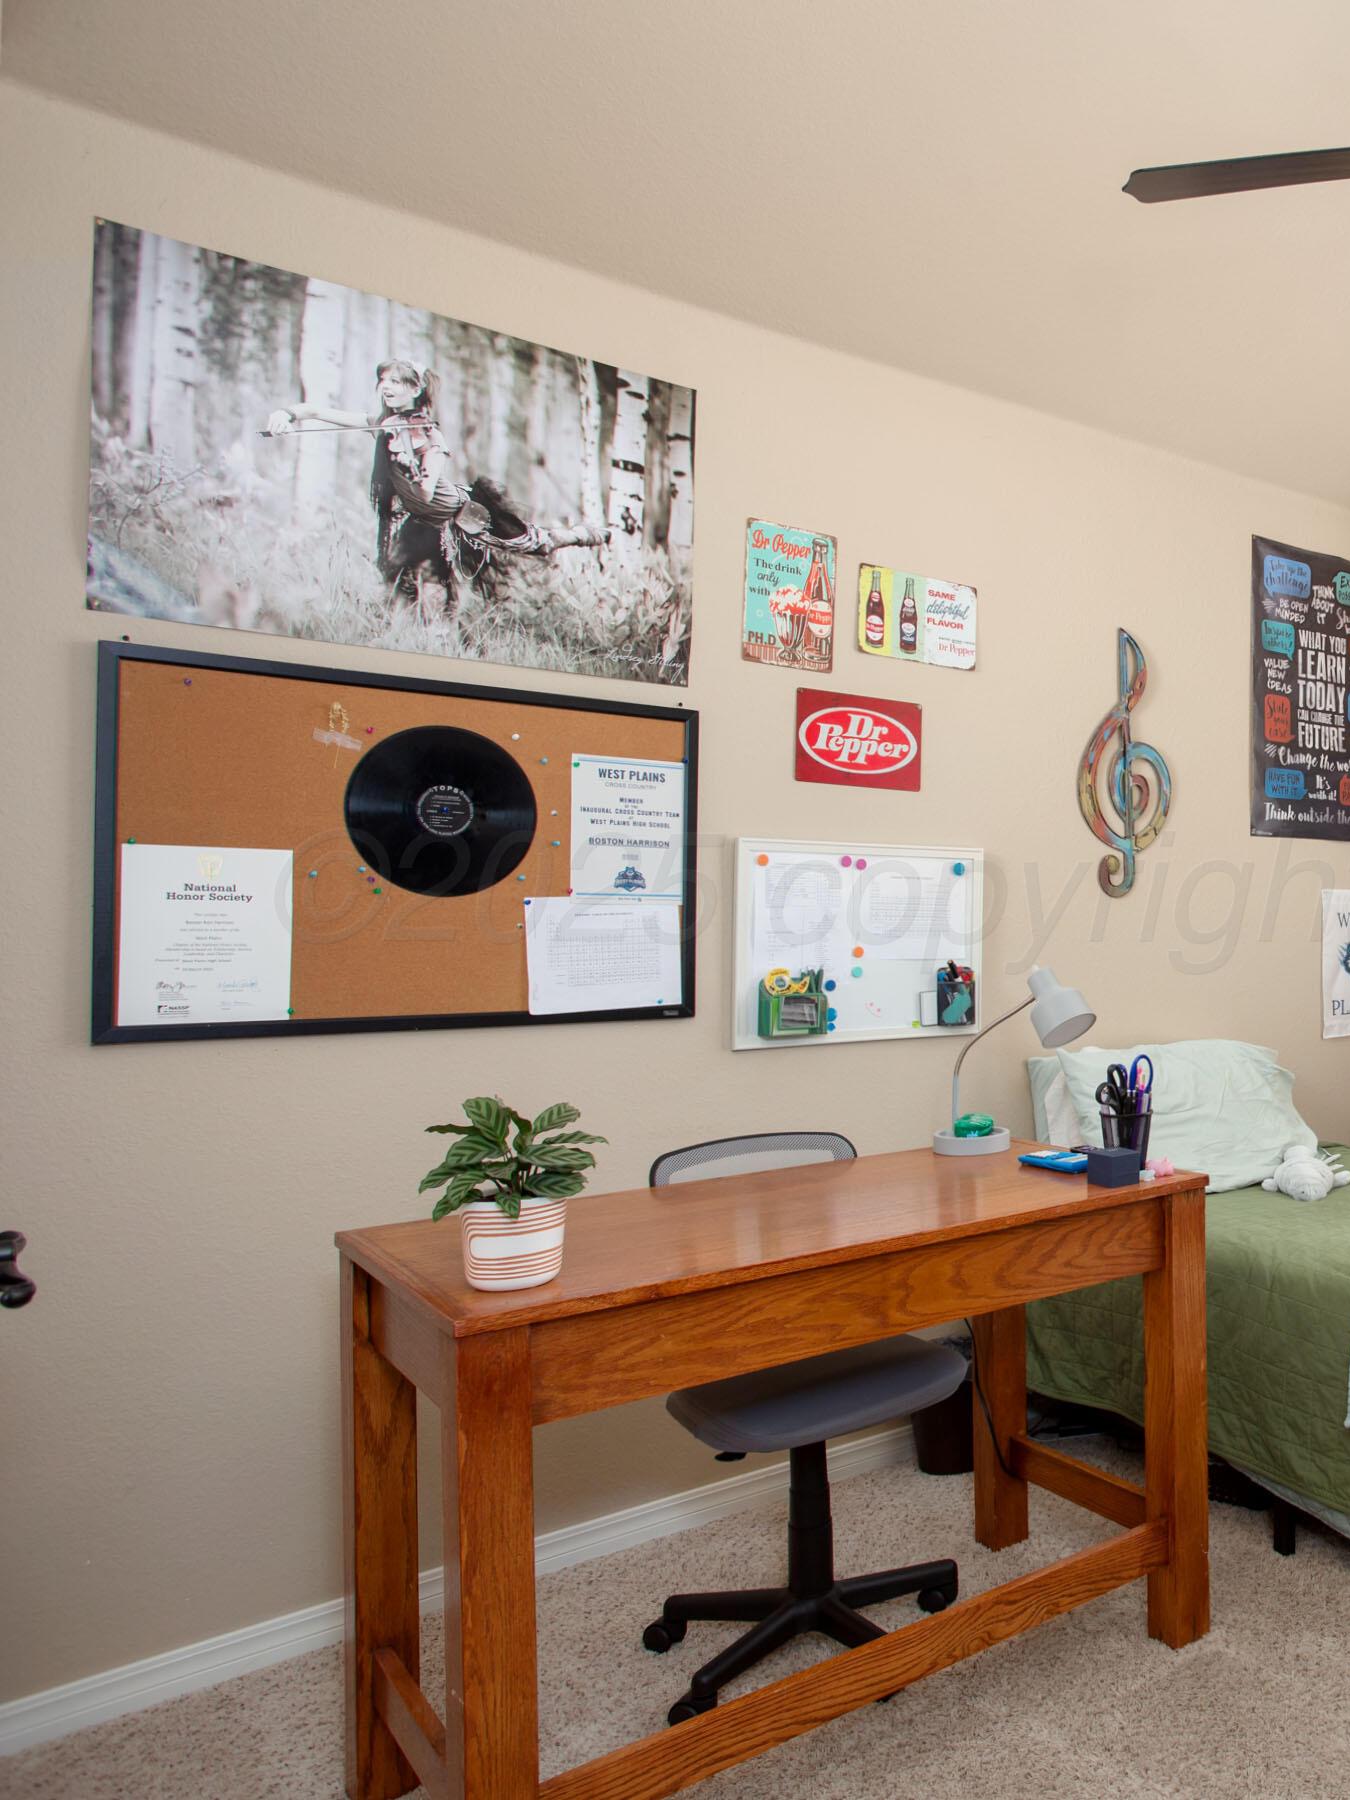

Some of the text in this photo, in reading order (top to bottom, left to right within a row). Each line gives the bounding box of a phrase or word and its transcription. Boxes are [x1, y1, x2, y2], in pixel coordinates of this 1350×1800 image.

[752, 528, 812, 560] Dr Pepper
[753, 557, 802, 576] The drink
[757, 571, 780, 588] only
[748, 585, 771, 597] with
[928, 589, 957, 601] SAME
[1312, 585, 1336, 600] THINK
[926, 599, 971, 620] delightful
[1279, 598, 1310, 614] BE OPEN
[1311, 599, 1336, 614] ABOUT
[927, 617, 965, 630] FLAVOR
[1274, 608, 1306, 624] MINDED
[747, 630, 776, 646] PH.D
[1298, 629, 1347, 656] WHAT YOU
[939, 643, 975, 658] Dr Pepper
[1263, 658, 1291, 670] VALUE
[1297, 648, 1347, 686] LEARN
[1267, 668, 1287, 681] NEW
[1266, 679, 1293, 695] IDEAS
[1296, 679, 1347, 715] TODAY
[1297, 708, 1345, 727] CAN CHANGE THE
[842, 713, 889, 741] Dr
[811, 722, 910, 765] Pepper
[1297, 721, 1347, 753] FUTURE
[1278, 745, 1319, 771] Change
[1319, 753, 1336, 772] the
[598, 768, 666, 783] WEST PLAINS
[1315, 774, 1332, 790] It's
[604, 781, 657, 790] CROSS COUNTRY
[580, 806, 612, 814] INAUGURAL
[614, 808, 635, 816] CROSS
[637, 809, 663, 817] COUNTRY
[1263, 801, 1297, 822] Think
[1297, 806, 1335, 824] outside
[609, 819, 631, 827] PLAINS
[632, 820, 647, 828] HIGH
[648, 821, 671, 829] SCHOOL
[588, 837, 670, 848] BOSTON HARRISON
[183, 882, 237, 893] National
[166, 891, 253, 904] Honor Society
